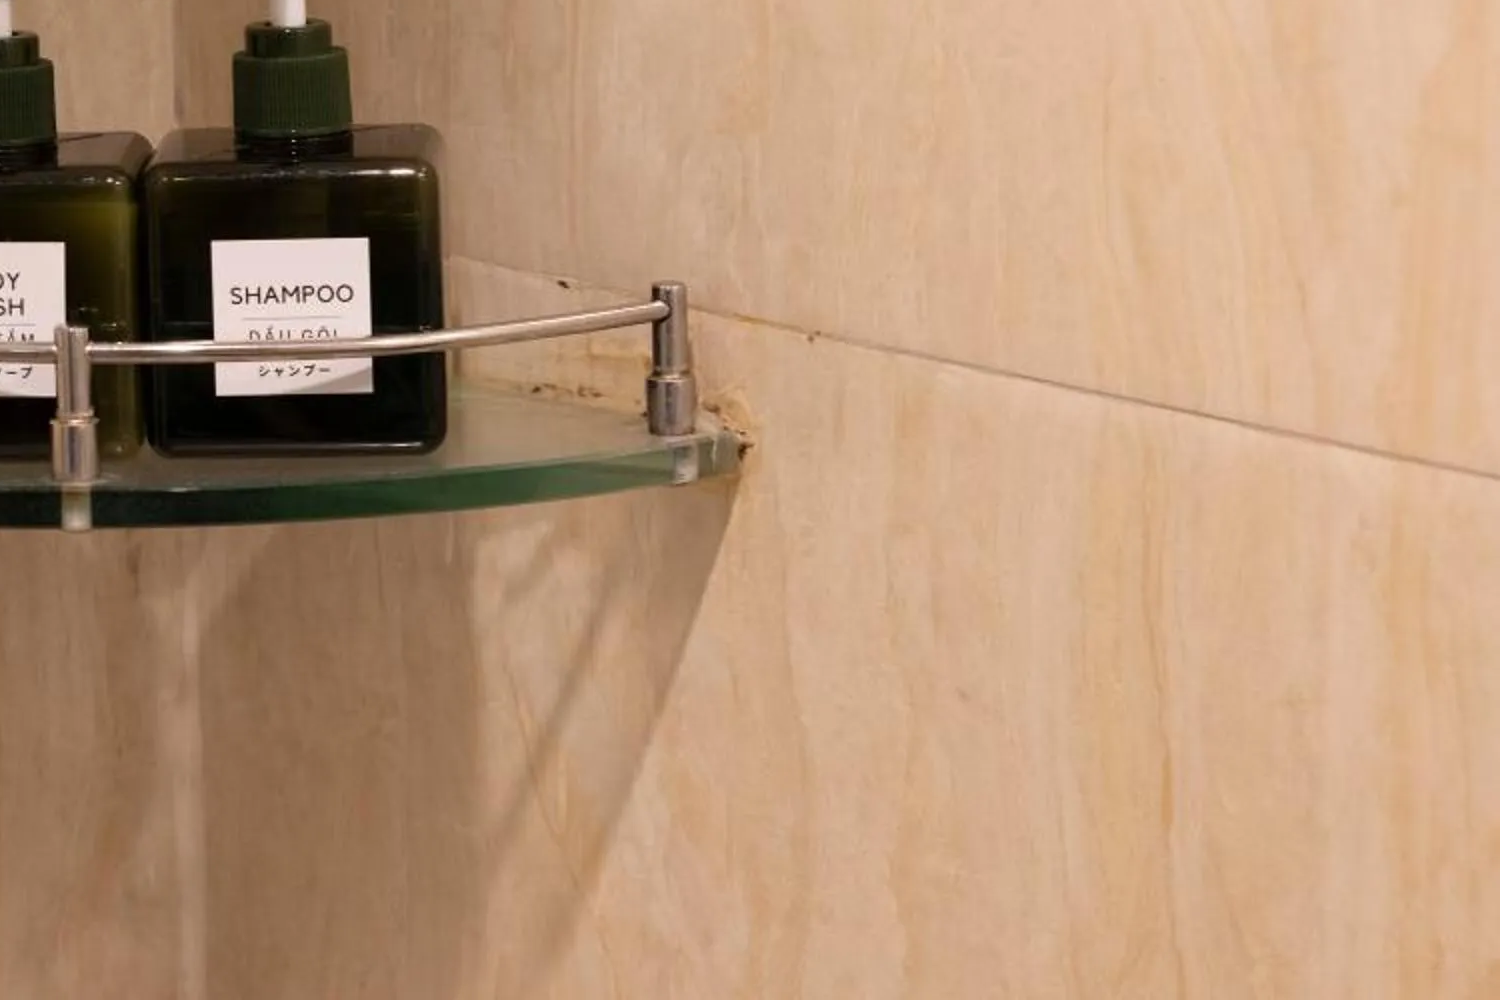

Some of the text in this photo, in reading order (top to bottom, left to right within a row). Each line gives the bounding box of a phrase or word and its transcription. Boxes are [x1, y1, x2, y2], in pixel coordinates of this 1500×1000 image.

[230, 283, 355, 305] SHAMPOO
[259, 364, 331, 377] シャンプー
